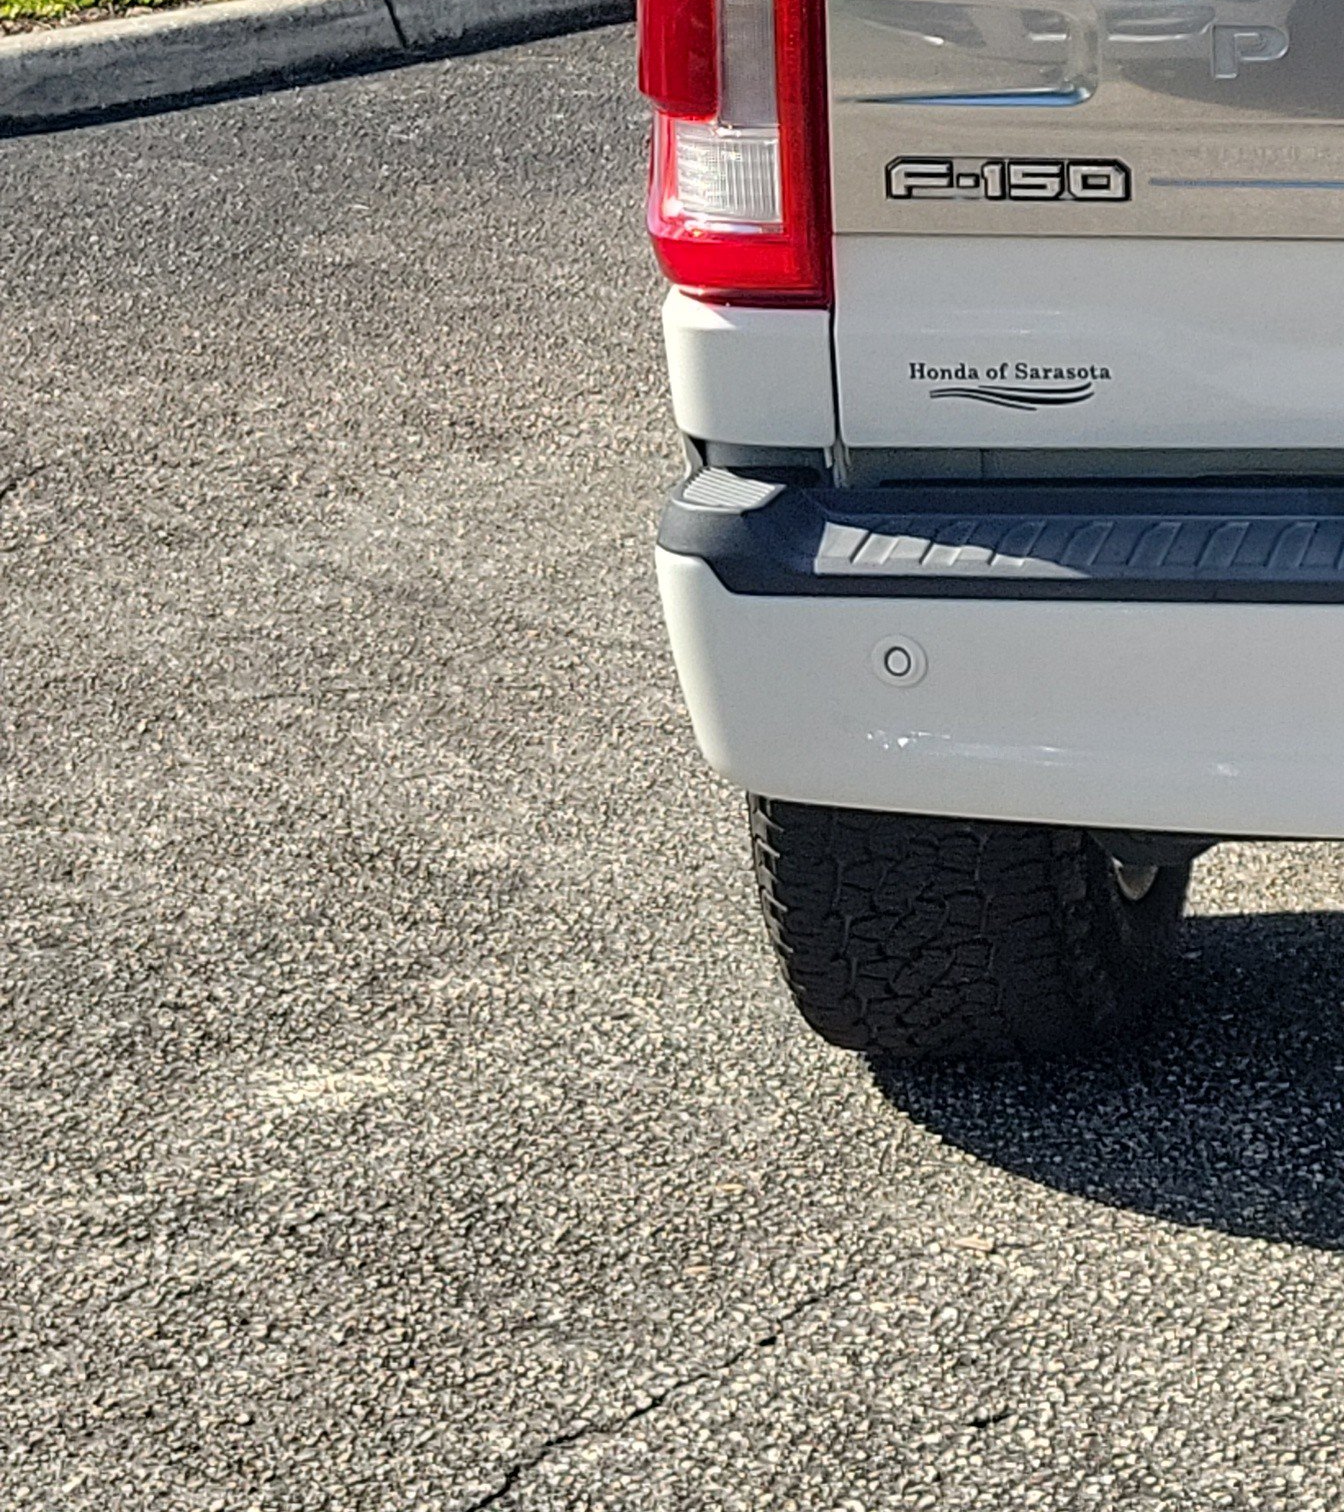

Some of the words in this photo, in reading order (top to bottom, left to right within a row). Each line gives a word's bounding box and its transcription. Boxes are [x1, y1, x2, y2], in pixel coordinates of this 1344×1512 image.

[886, 156, 1132, 202] F-150
[909, 363, 979, 380] Honda
[986, 363, 1009, 380] of
[1015, 363, 1112, 380] Sarasota
